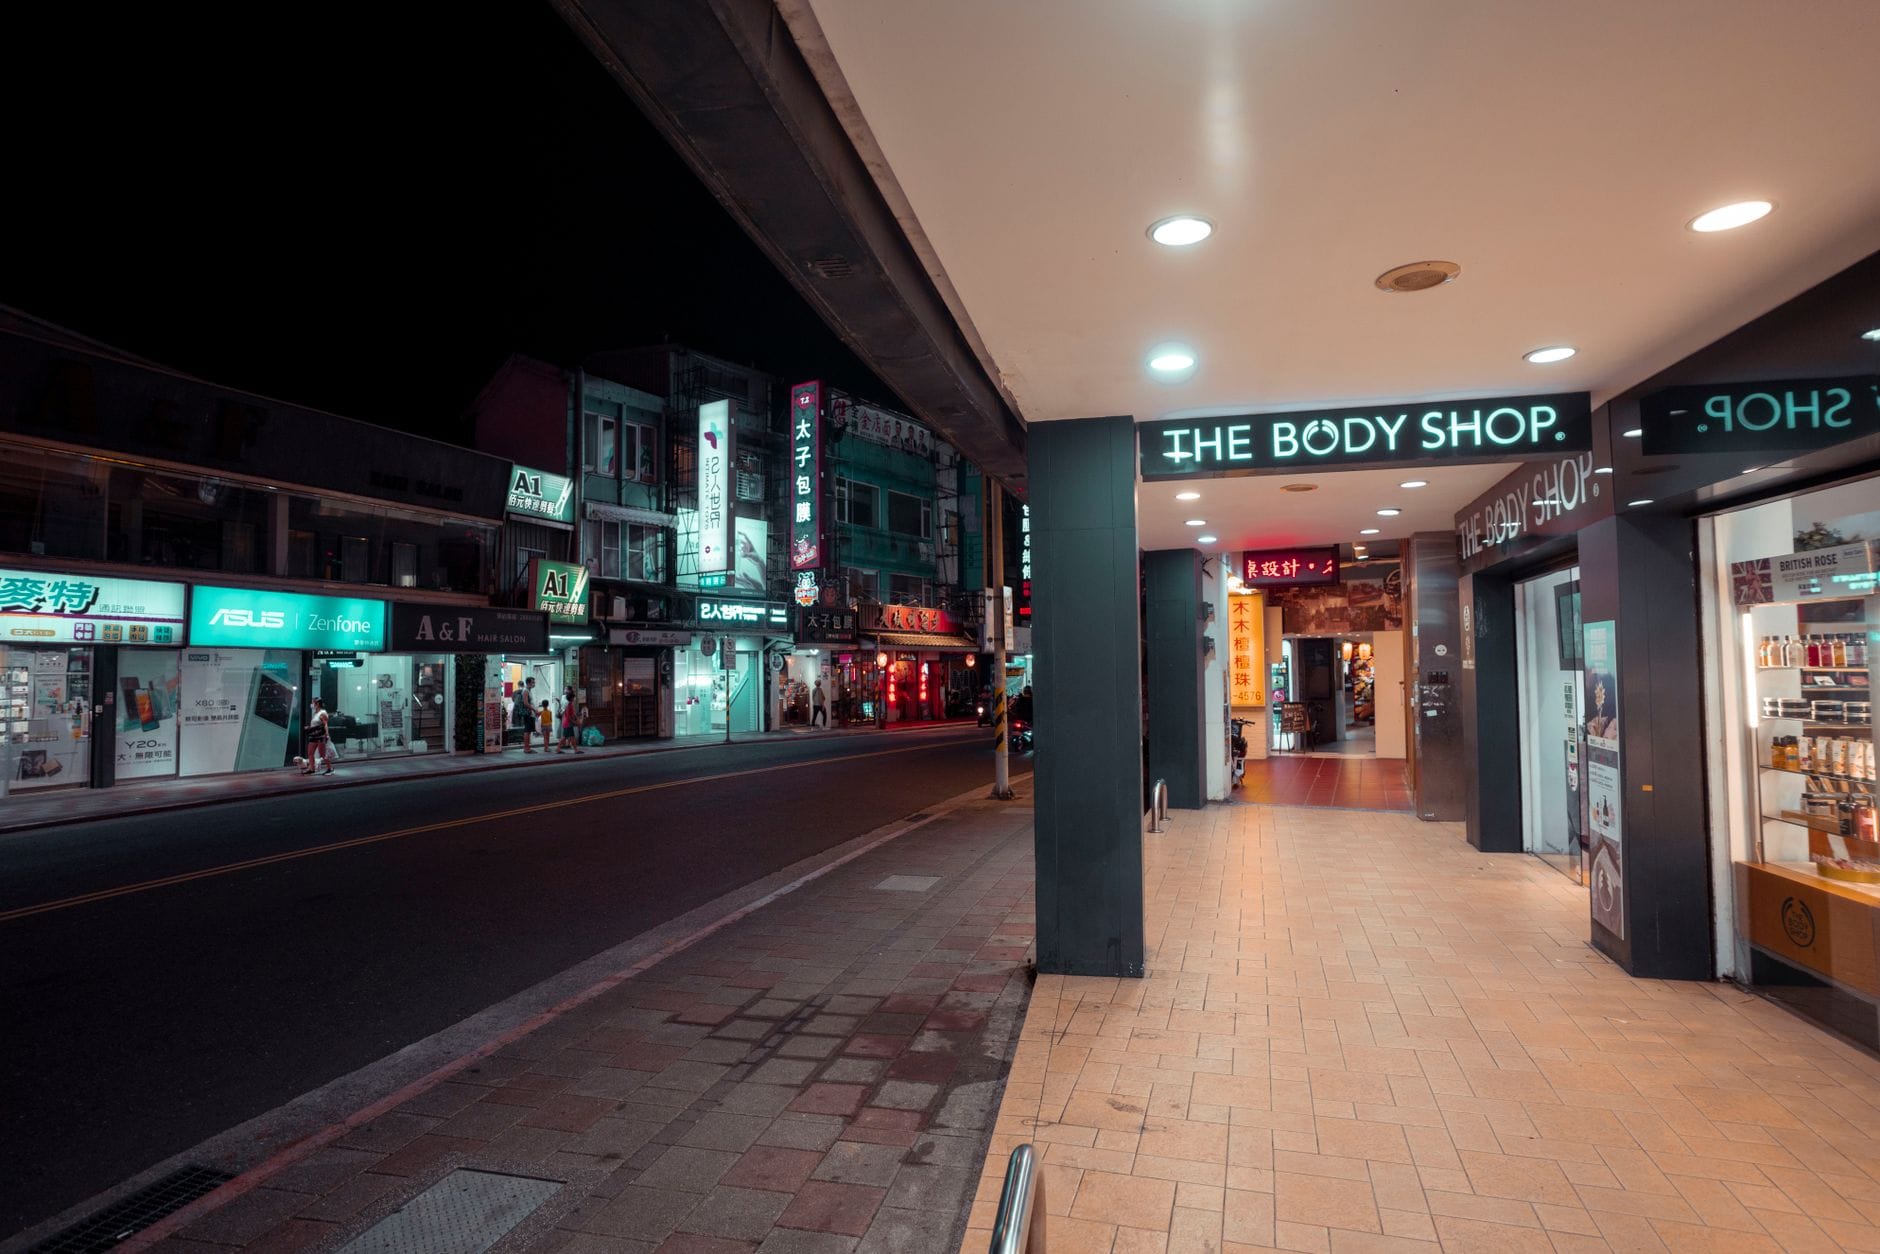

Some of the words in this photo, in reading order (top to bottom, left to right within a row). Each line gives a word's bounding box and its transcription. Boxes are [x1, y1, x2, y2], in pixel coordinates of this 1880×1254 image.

[1163, 425, 1253, 463] THE
[1273, 414, 1408, 457] BODY
[1421, 405, 1558, 450] SHOP
[512, 470, 543, 498] A1
[795, 418, 812, 524] 太子包膜
[1459, 512, 1483, 560] THE
[1485, 482, 1529, 548] BODY
[1533, 451, 1593, 526] SHOP
[1779, 556, 1813, 572] BRITISH
[1814, 553, 1838, 568] ROSE
[0, 577, 95, 612] 麥特
[542, 569, 570, 599] A1
[208, 608, 285, 629] ASUS
[308, 613, 371, 634] Zenfone
[415, 614, 435, 641] A
[439, 622, 454, 642] &
[457, 617, 474, 642] F
[477, 633, 498, 643] HAIR
[500, 634, 526, 644] SALON
[125, 739, 157, 749] Y20
